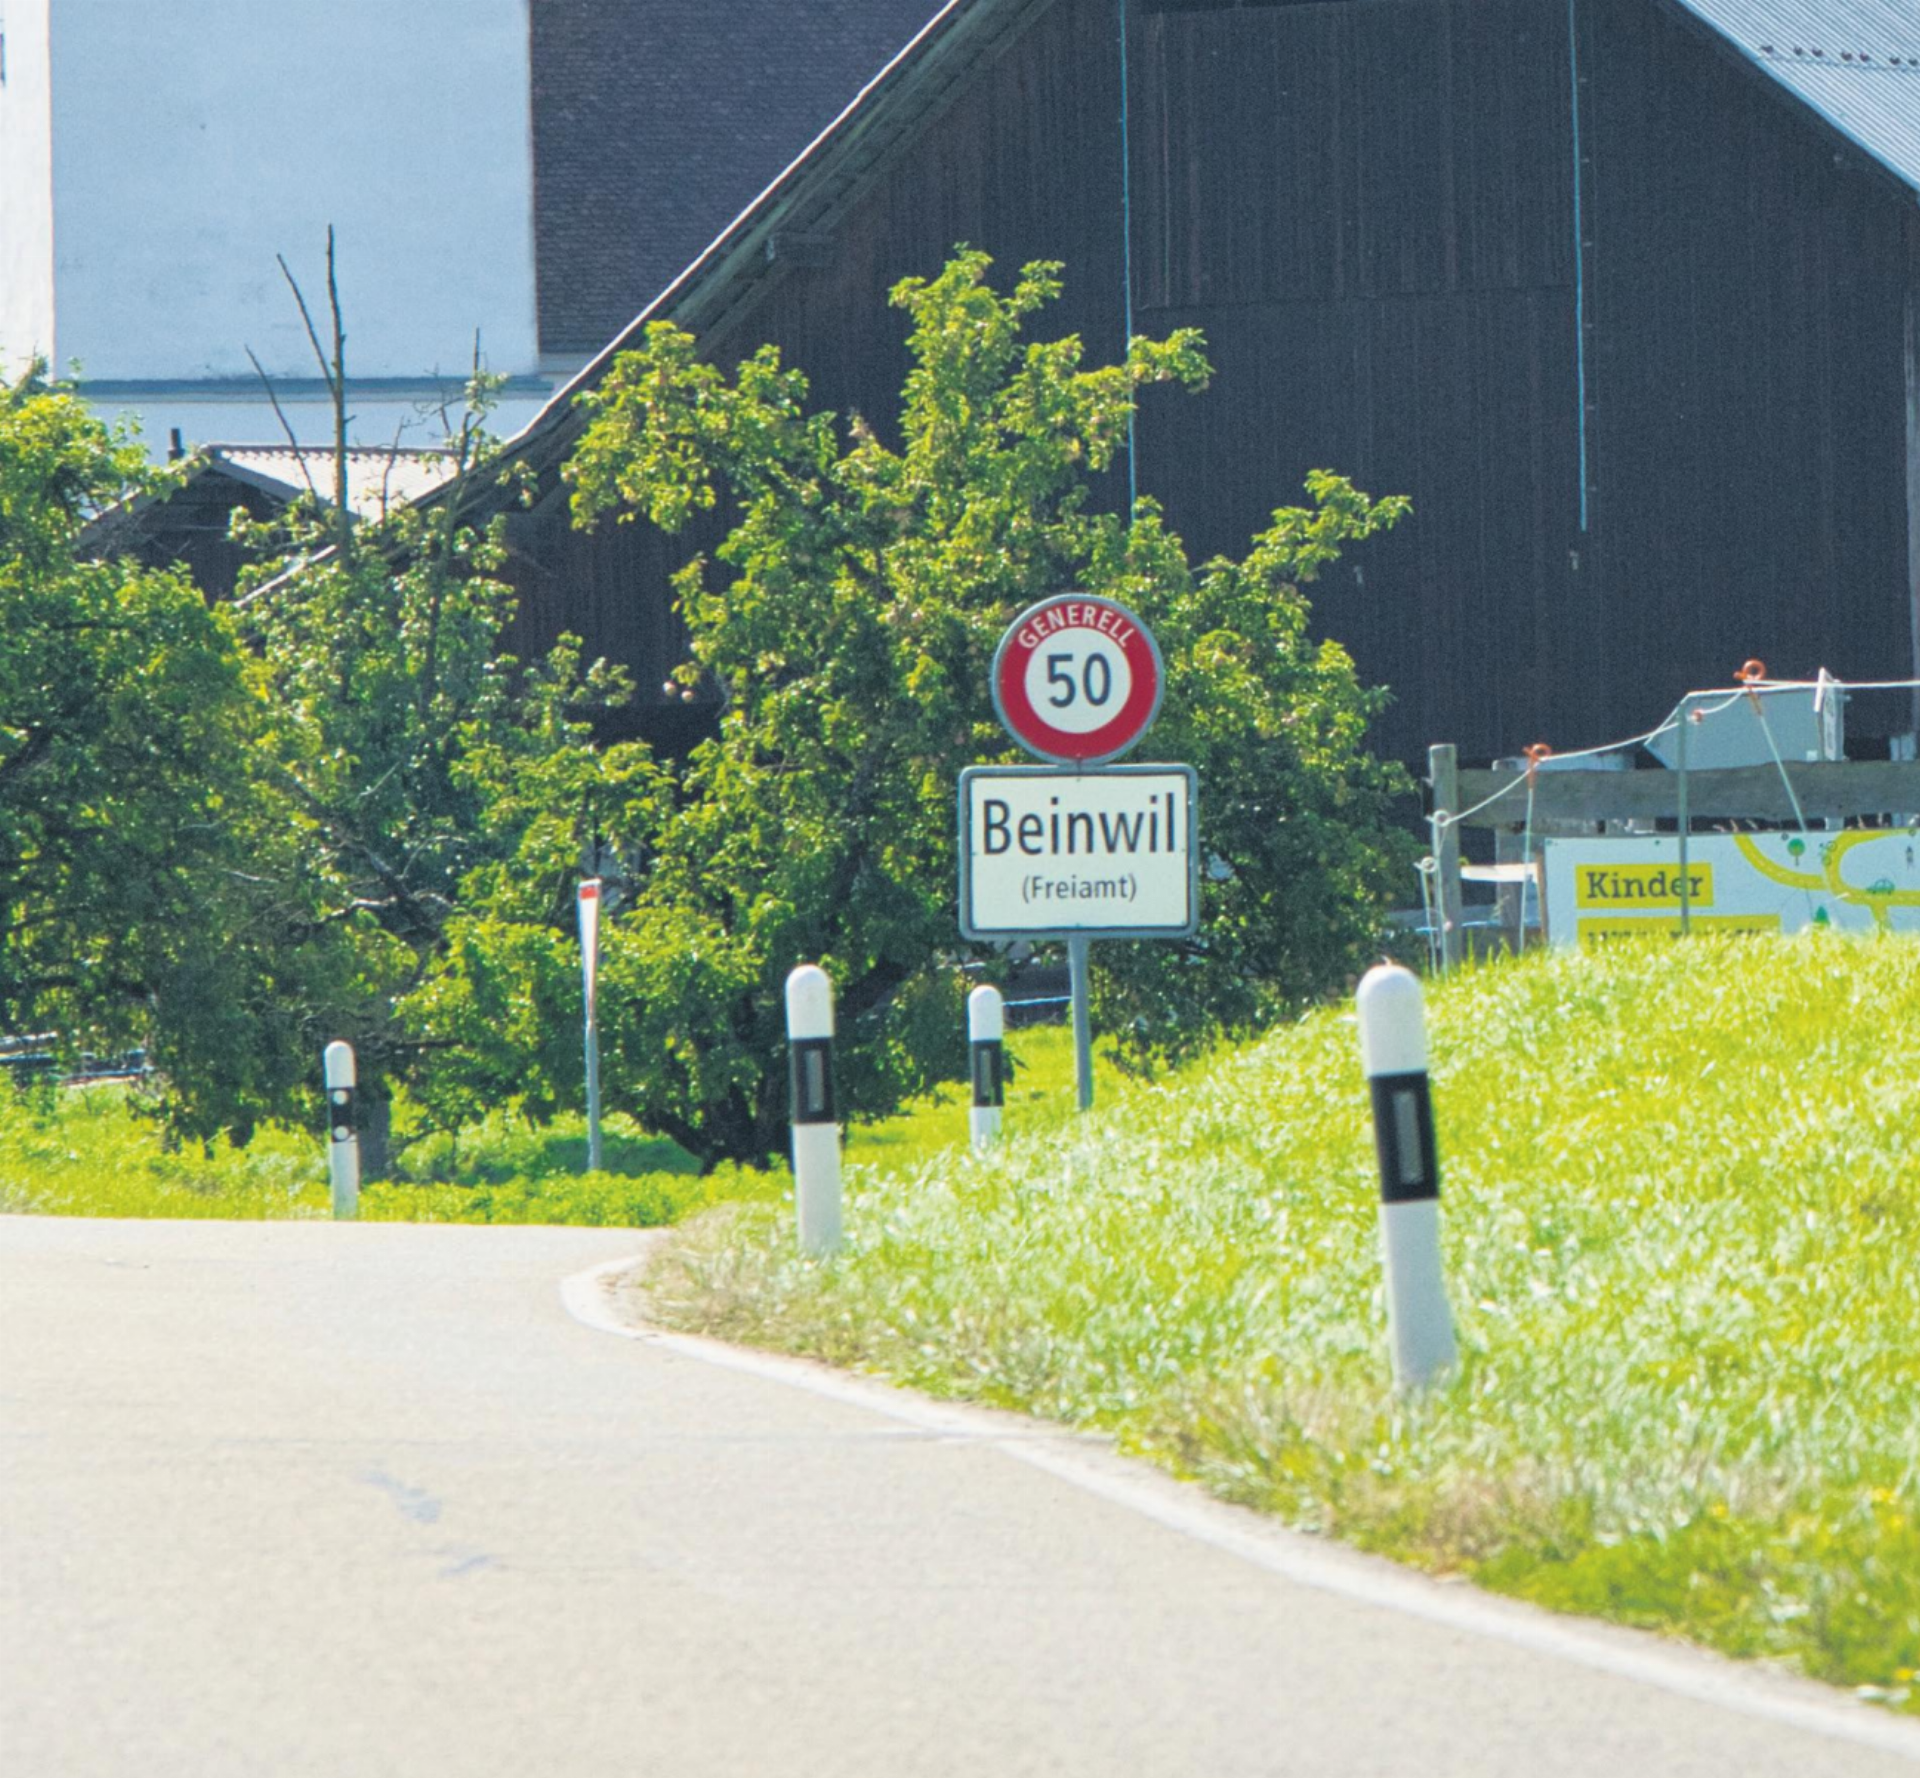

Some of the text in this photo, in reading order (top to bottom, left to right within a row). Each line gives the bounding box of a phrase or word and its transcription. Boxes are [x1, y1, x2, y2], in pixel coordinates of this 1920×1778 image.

[1018, 604, 1135, 648] GENERELL
[1047, 653, 1111, 707] 50
[983, 792, 1176, 855] Beinwil
[1022, 873, 1138, 903] (Freiamt)
[1586, 871, 1703, 898] Kinder
